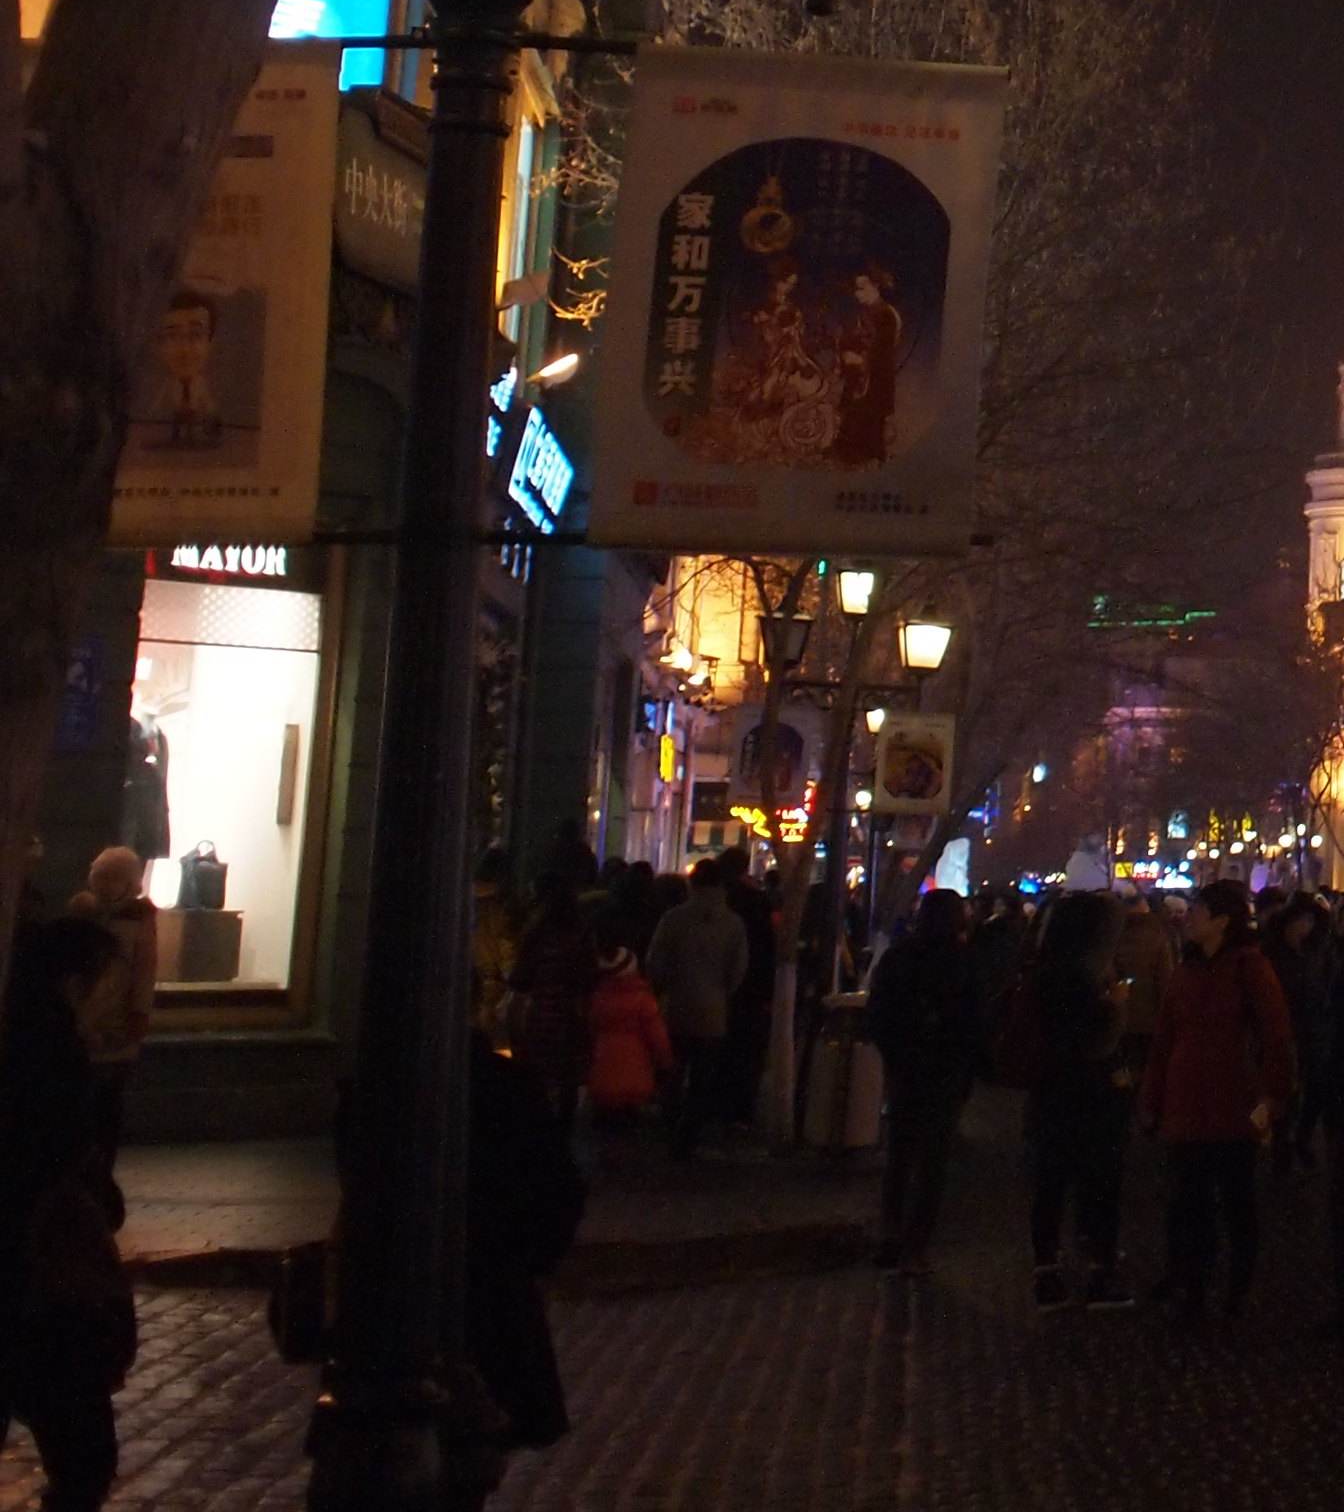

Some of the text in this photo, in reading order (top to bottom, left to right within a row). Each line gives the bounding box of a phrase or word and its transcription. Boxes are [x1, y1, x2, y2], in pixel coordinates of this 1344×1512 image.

[658, 191, 717, 396] 家和万事兴
